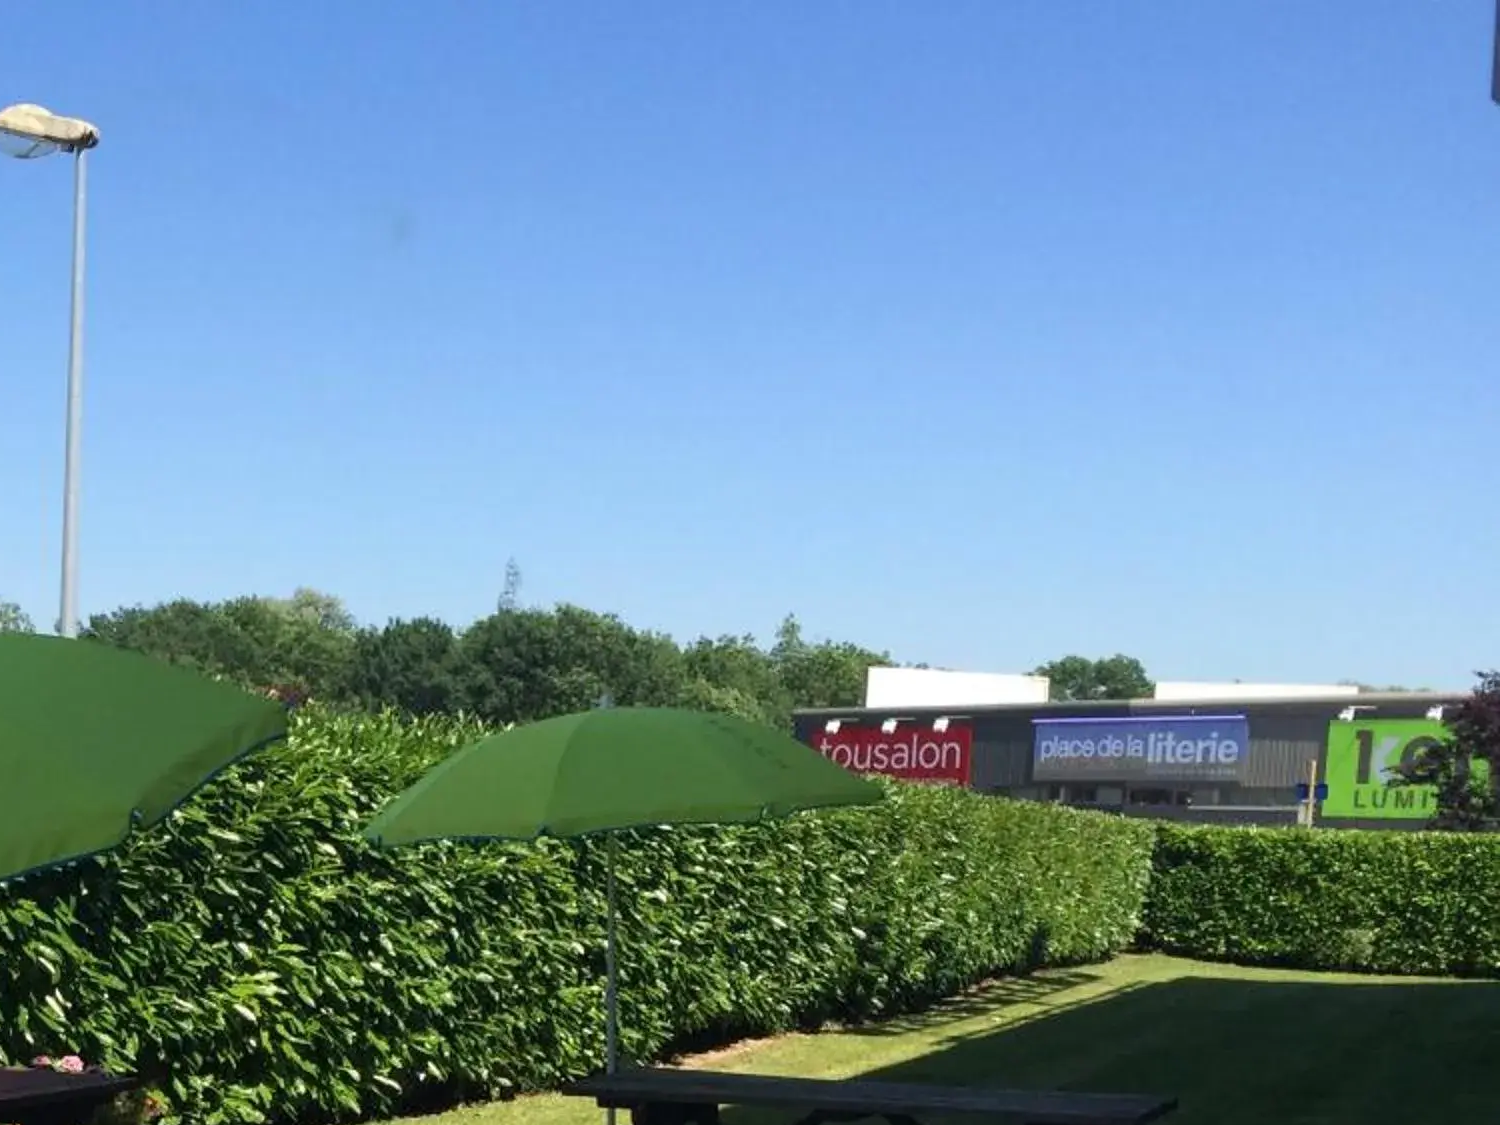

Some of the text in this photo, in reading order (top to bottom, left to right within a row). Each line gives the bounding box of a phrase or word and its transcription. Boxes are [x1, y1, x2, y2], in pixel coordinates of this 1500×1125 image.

[819, 734, 961, 769] tousalon
[1040, 731, 1239, 763] place de la literie
[1353, 789, 1430, 809] LUMI
